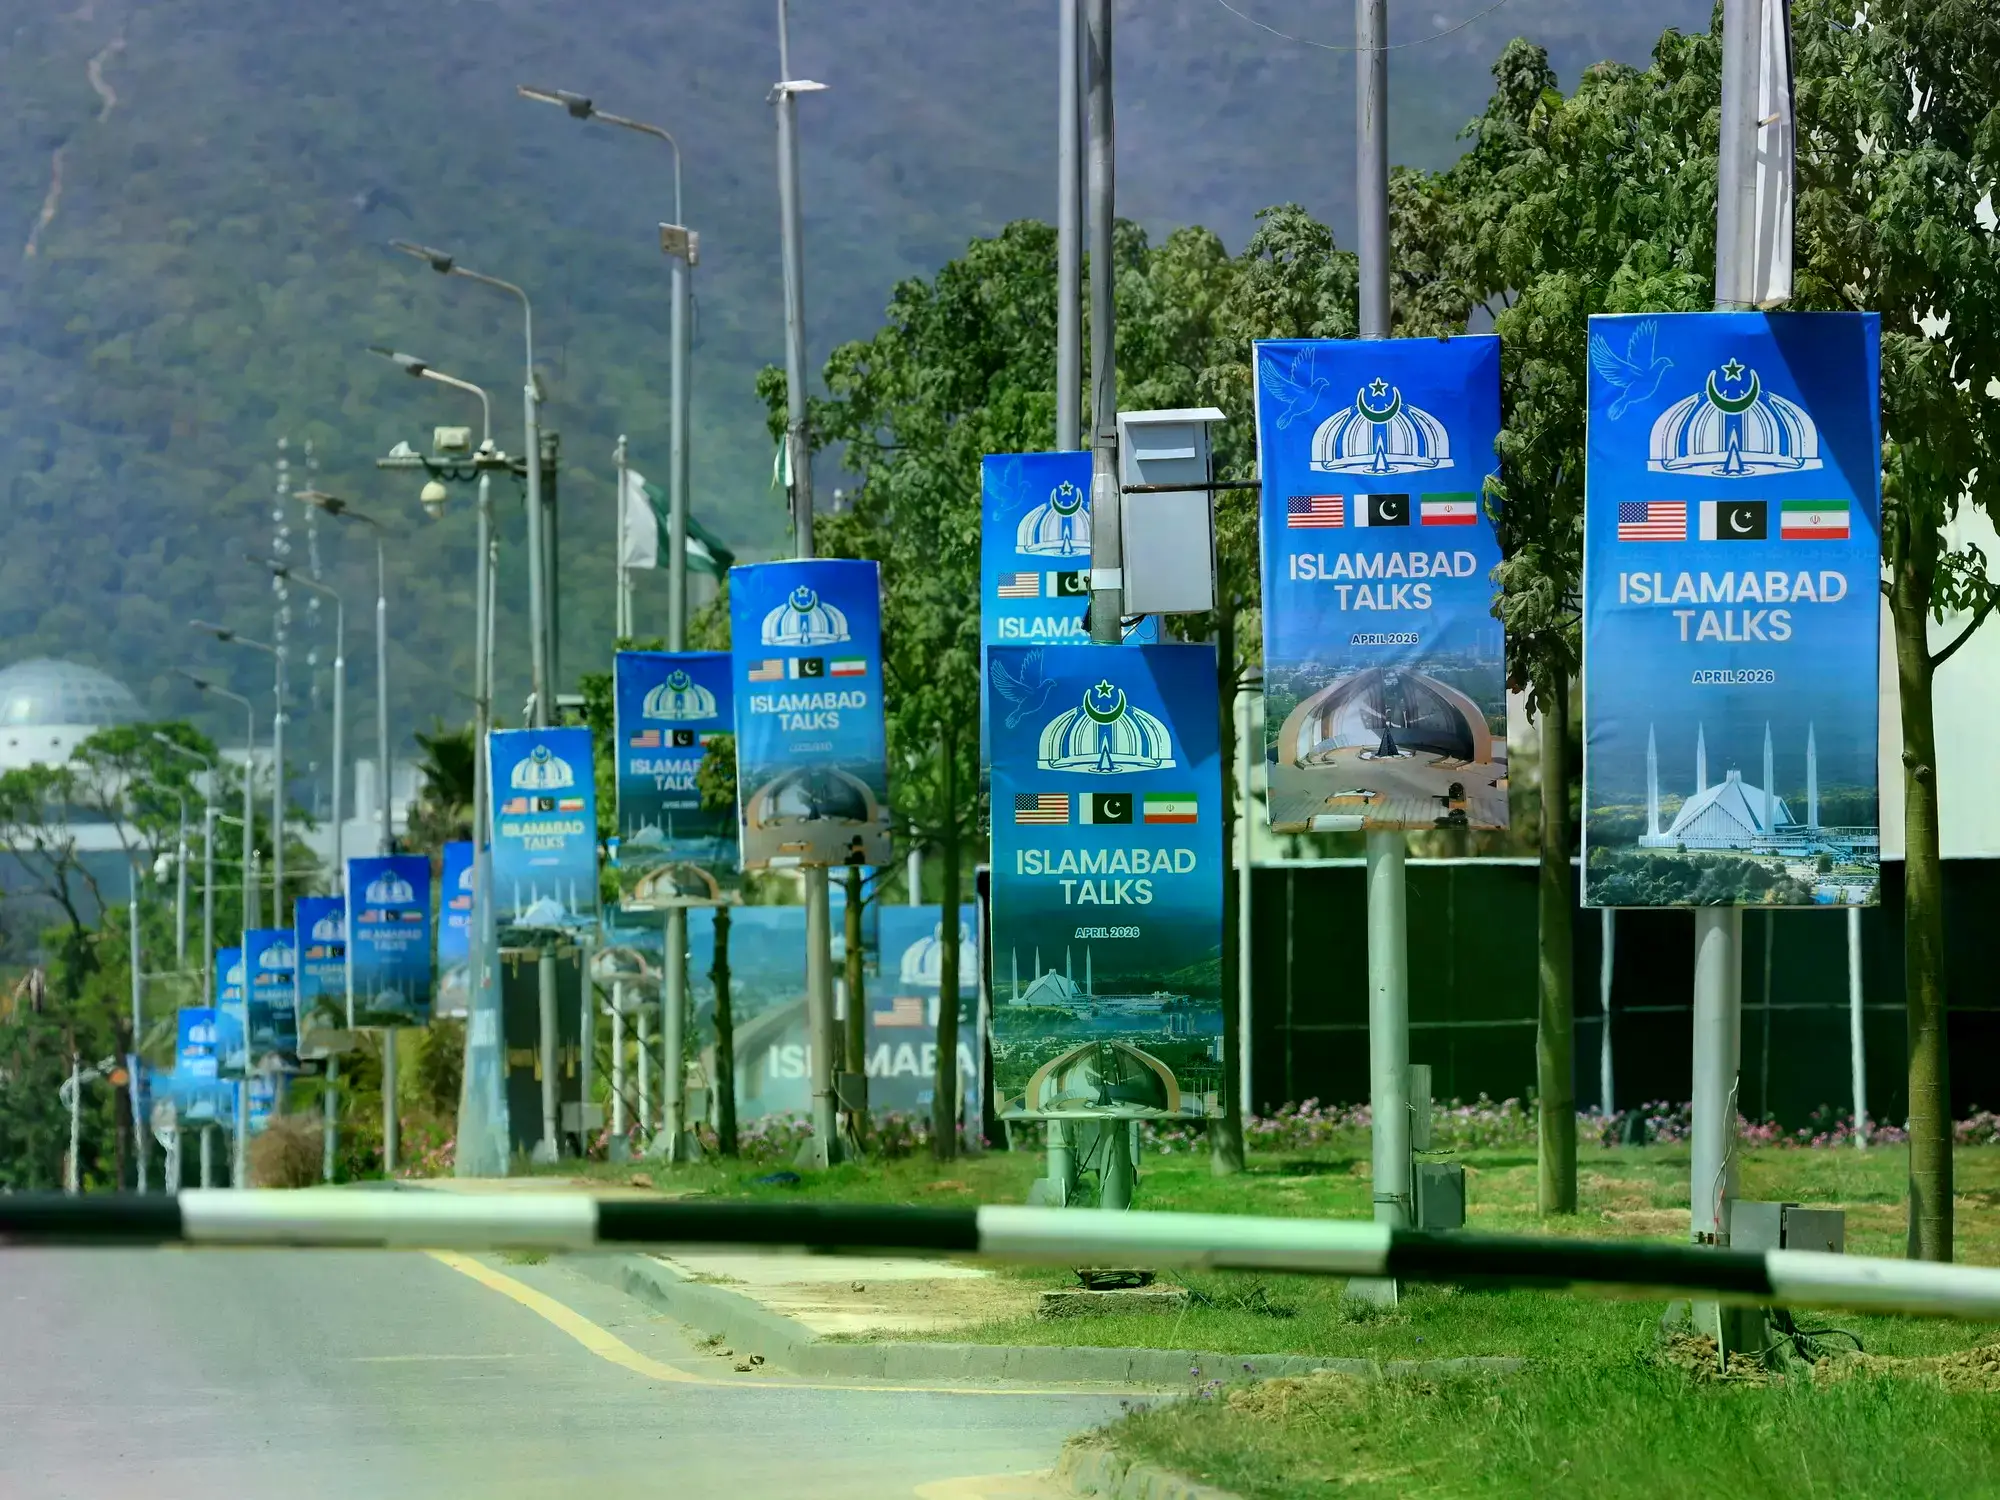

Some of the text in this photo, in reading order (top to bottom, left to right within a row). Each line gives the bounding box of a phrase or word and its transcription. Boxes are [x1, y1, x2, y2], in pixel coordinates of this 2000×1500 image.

[1290, 551, 1477, 581] ISLAMABAD
[1334, 583, 1433, 611] TALKS
[1619, 570, 1848, 604] ISLAMABAD
[998, 616, 1137, 638] ISLAMA
[1672, 609, 1792, 642] TALKS
[1351, 632, 1419, 645] APRIL 2026
[1691, 669, 1775, 684] APRIL 2026
[750, 690, 867, 714] ISLAMABAD
[778, 711, 840, 731] TALKS
[630, 758, 702, 775] ISLAMA
[655, 774, 698, 791] TALK
[502, 819, 585, 837] LAMAAD
[1016, 848, 1197, 875] ISLAMABAD
[1059, 879, 1153, 905] TALKS
[1075, 926, 1140, 939] APRIL 2026
[769, 1043, 977, 1078] ISMABA
